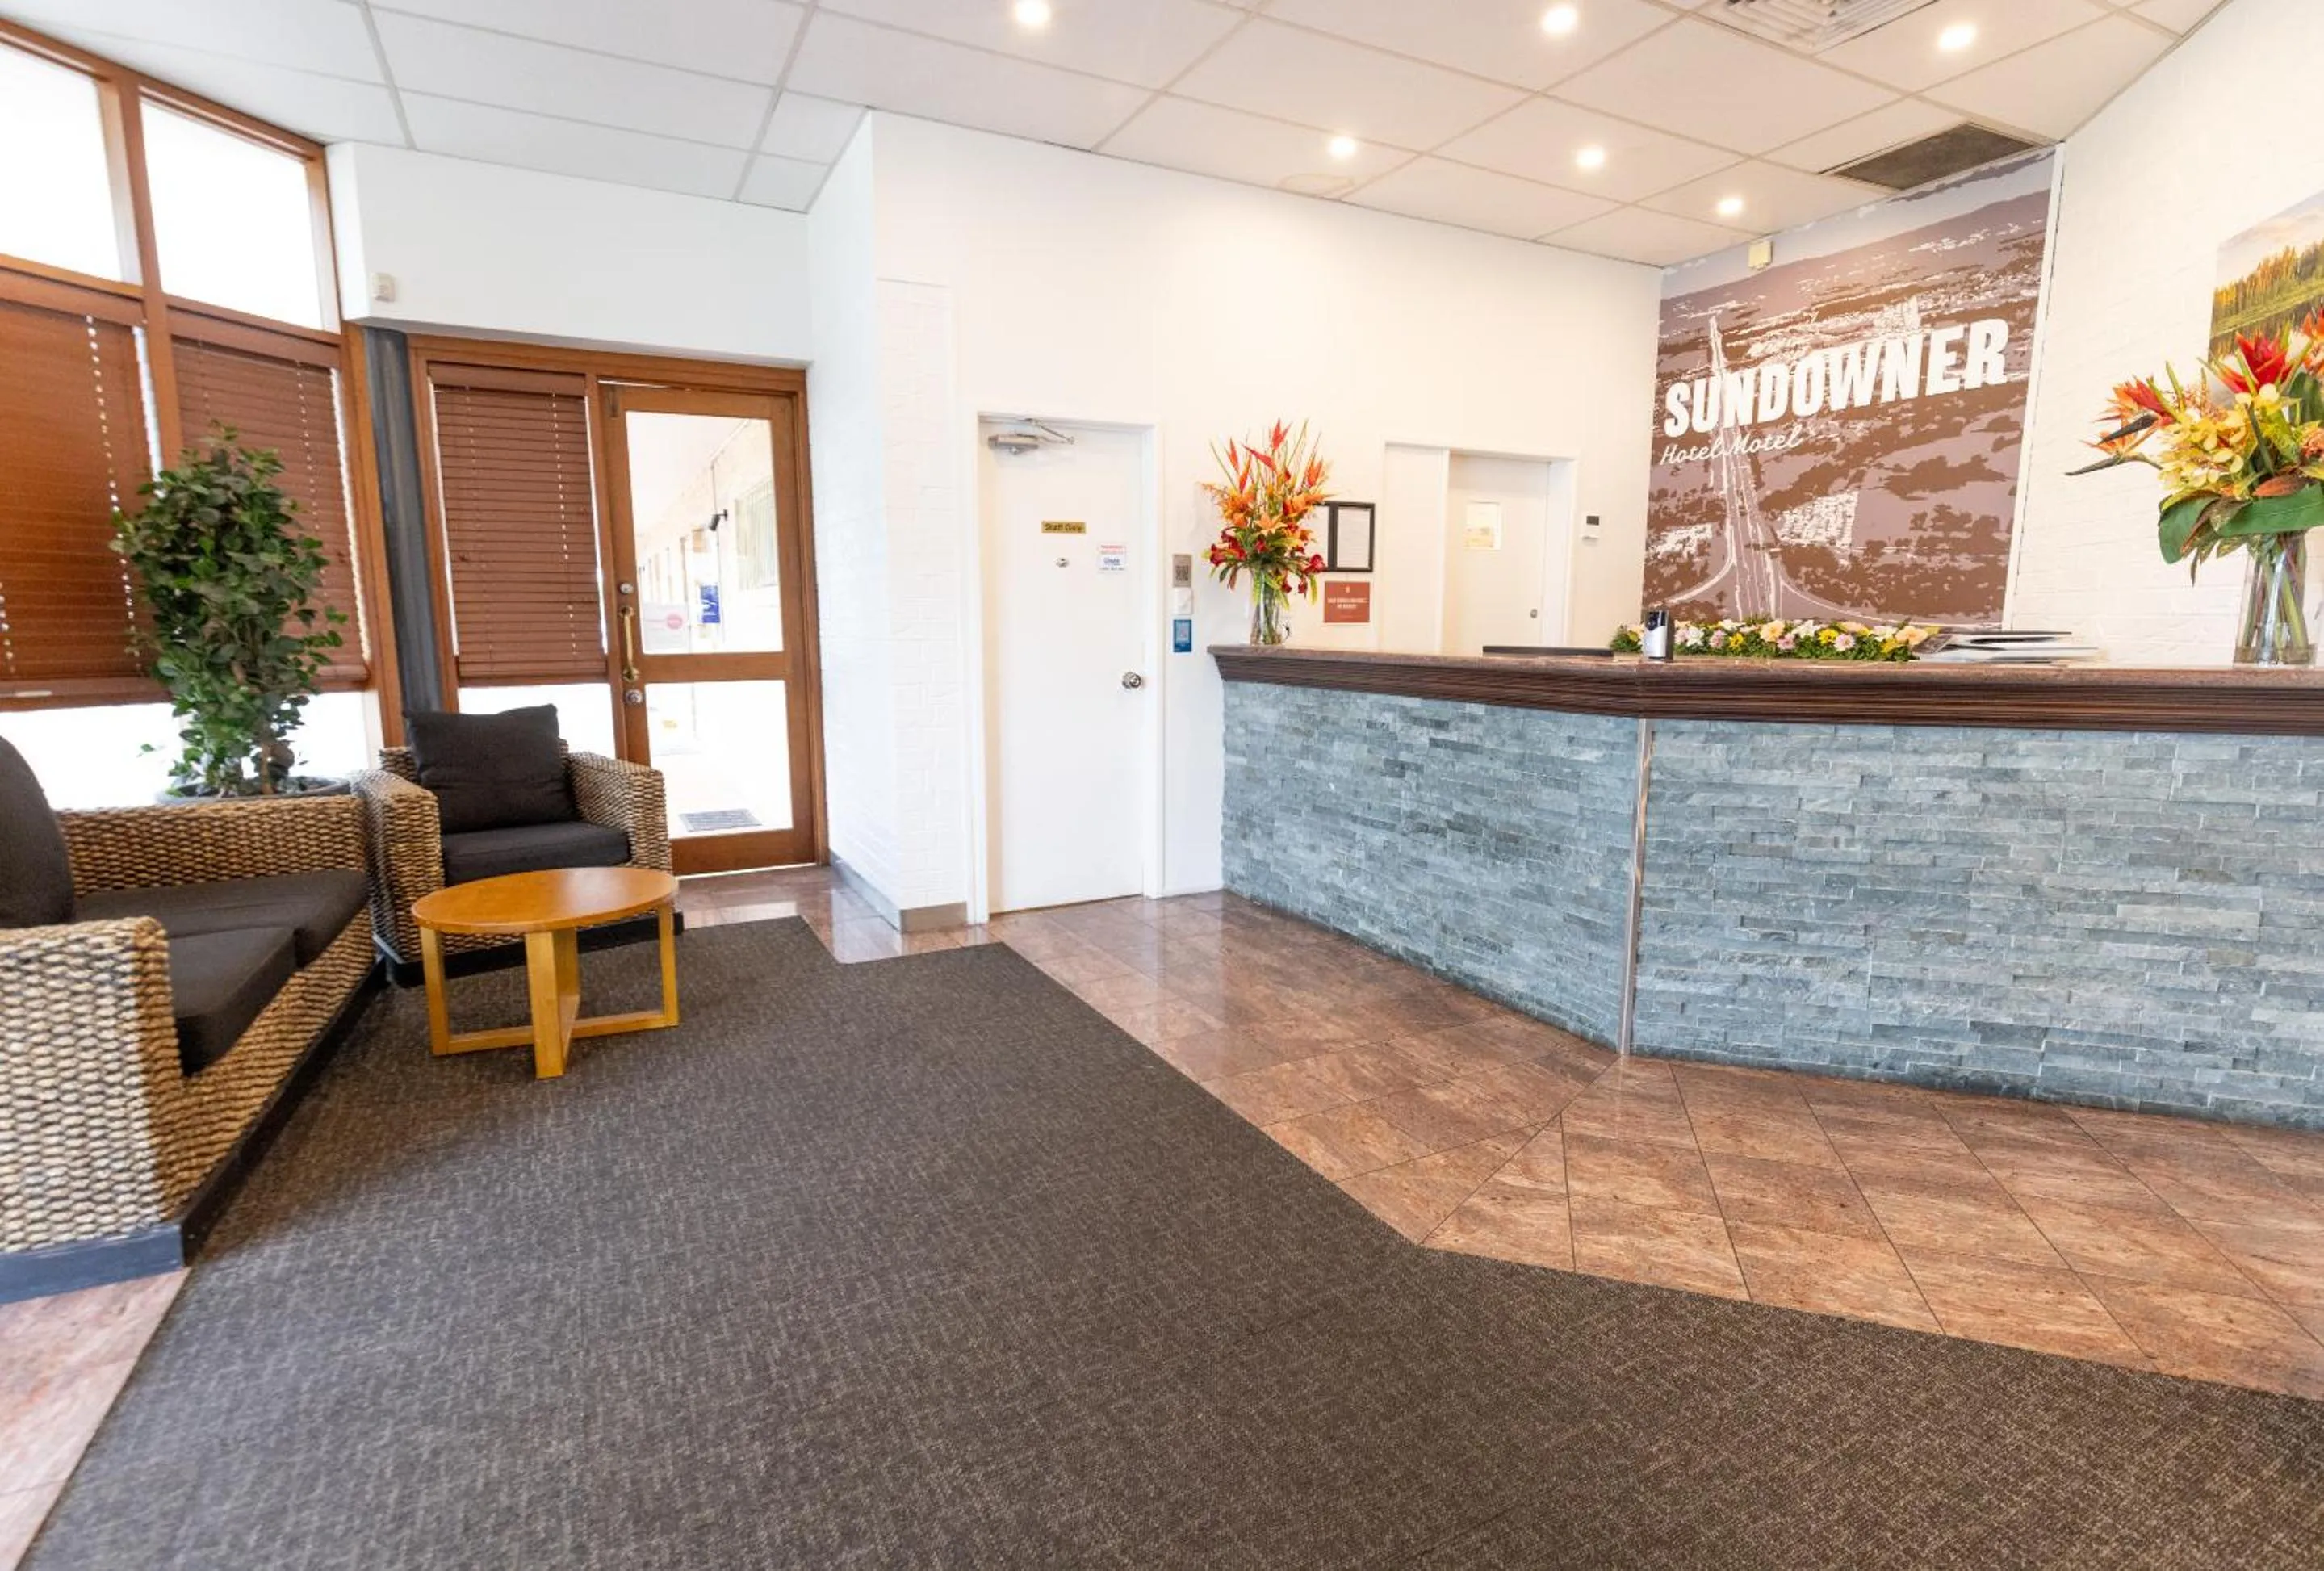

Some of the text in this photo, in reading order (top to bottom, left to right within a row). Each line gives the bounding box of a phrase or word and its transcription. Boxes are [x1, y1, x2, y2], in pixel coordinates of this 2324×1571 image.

[1664, 318, 2008, 437] SUNDOWNER
[1660, 424, 1803, 465] Hotel Motel
